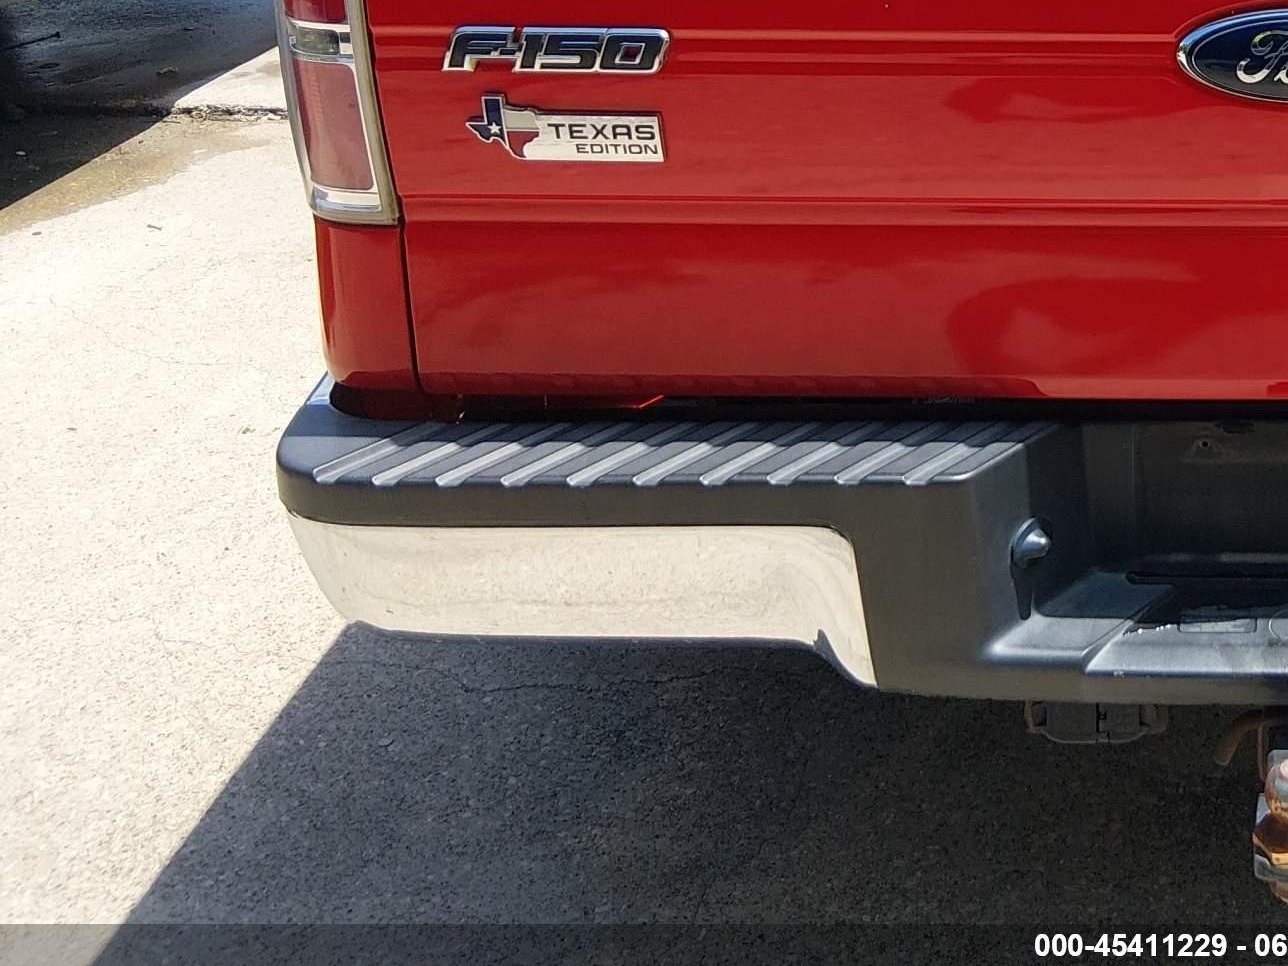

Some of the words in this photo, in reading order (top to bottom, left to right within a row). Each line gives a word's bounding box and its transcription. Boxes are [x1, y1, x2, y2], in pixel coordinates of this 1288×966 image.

[442, 26, 670, 74] F-150
[547, 123, 656, 140] TEXAS
[576, 143, 658, 155] EDITION
